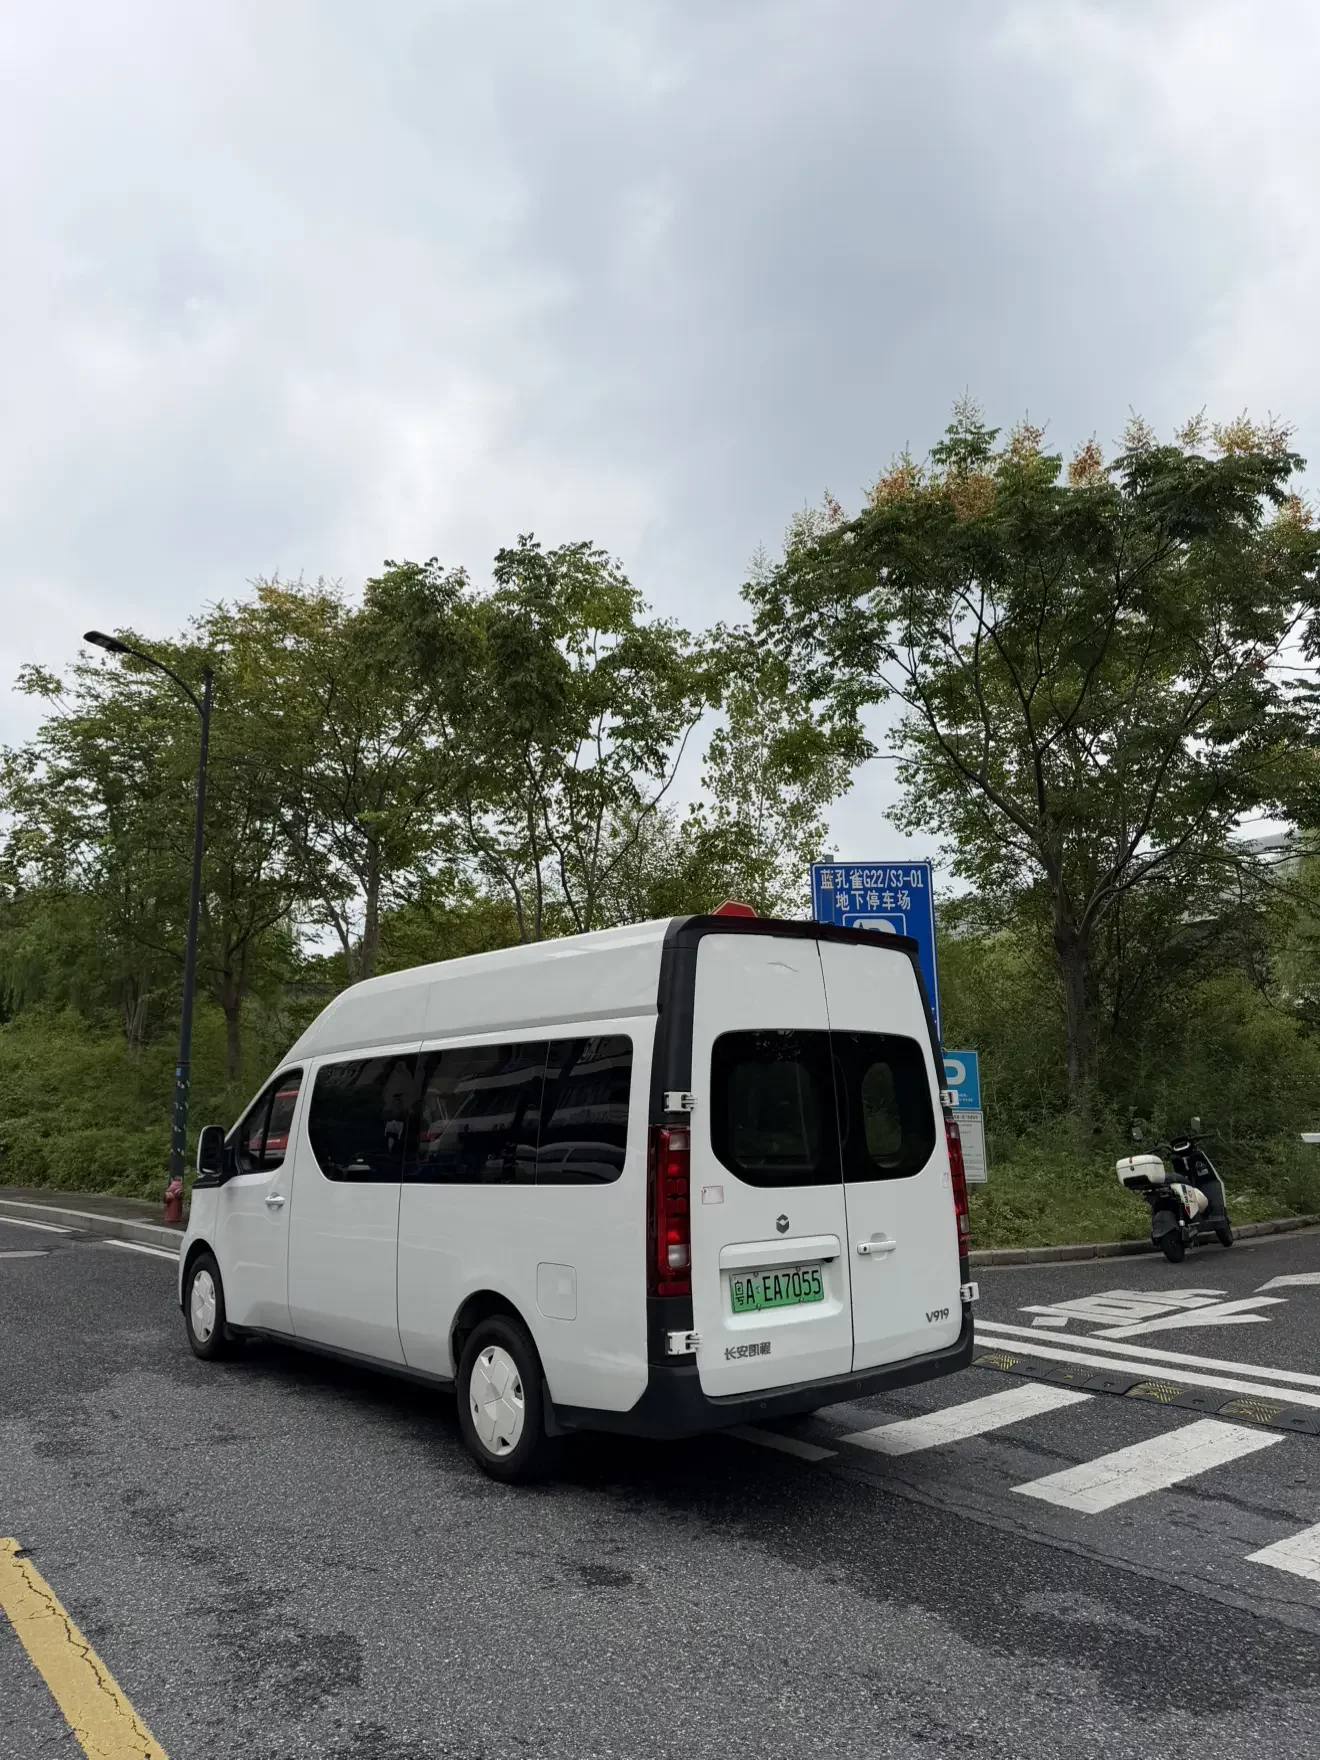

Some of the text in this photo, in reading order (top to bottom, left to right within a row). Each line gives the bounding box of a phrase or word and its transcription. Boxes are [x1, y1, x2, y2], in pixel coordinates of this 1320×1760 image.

[820, 868, 924, 889] 蓝孔雀G22/S3-01
[835, 890, 911, 911] 地下停车场
[925, 1308, 950, 1323] V919
[724, 1341, 771, 1361] 长安凯程
